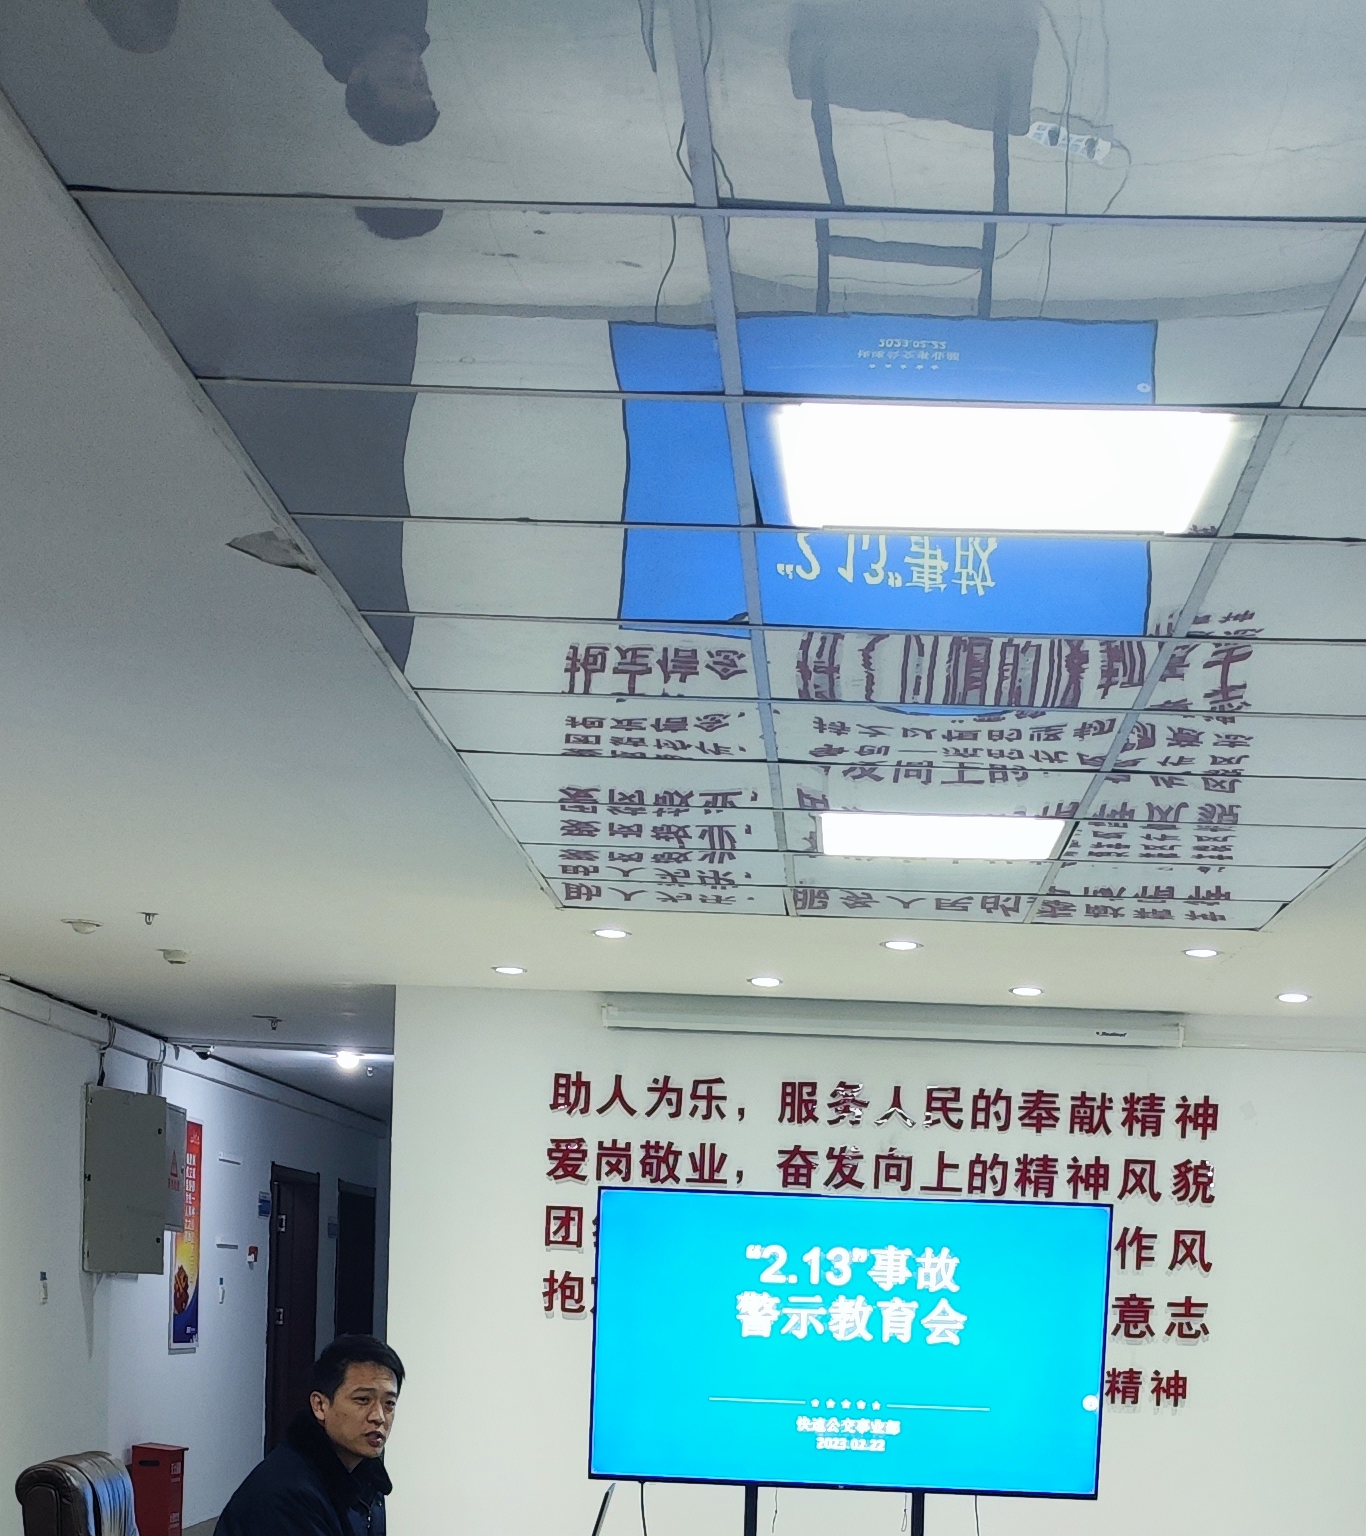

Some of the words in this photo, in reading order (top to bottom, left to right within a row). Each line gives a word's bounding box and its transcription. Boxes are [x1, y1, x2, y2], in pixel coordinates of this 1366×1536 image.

[544, 1205, 597, 1248] 团
[1113, 1225, 1213, 1273] 作风
[542, 1269, 596, 1314] 抱
[1110, 1293, 1210, 1339] 意志
[735, 1290, 968, 1346] 警示教育会
[1105, 1367, 1188, 1408] 精神
